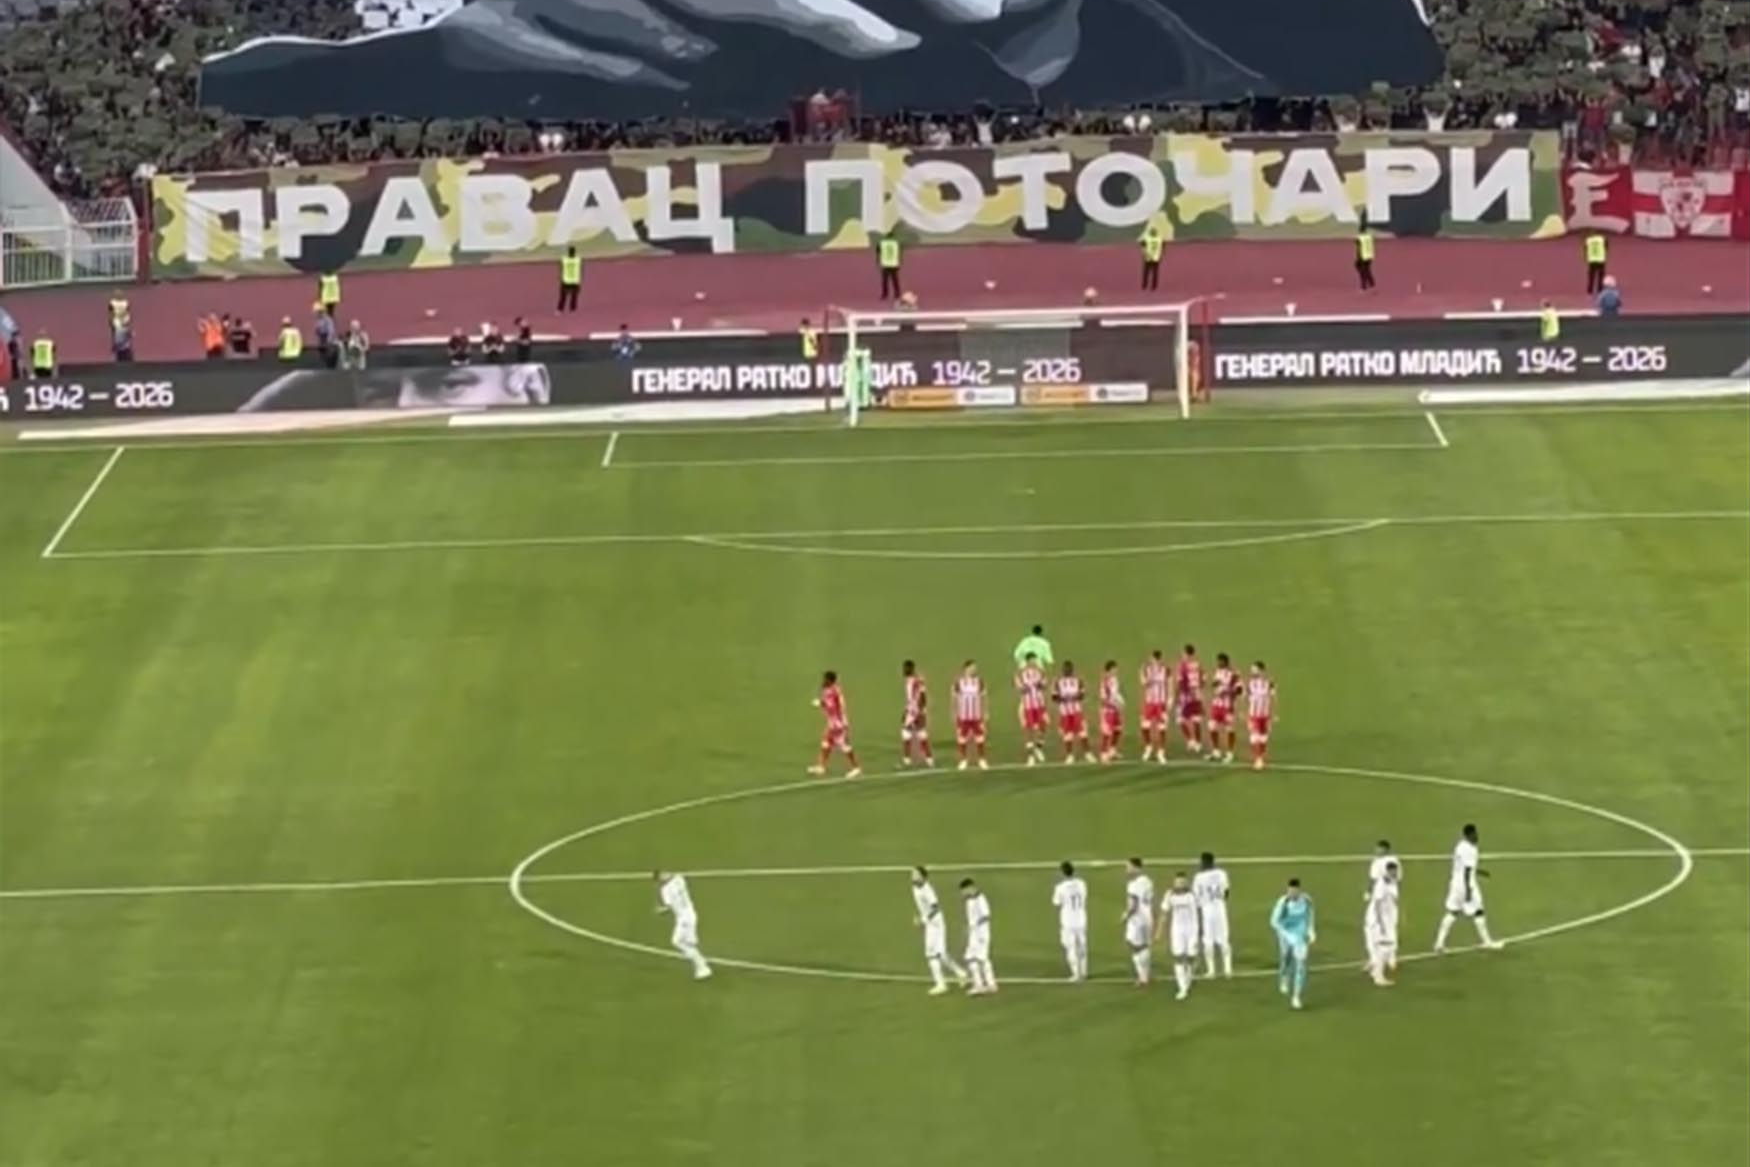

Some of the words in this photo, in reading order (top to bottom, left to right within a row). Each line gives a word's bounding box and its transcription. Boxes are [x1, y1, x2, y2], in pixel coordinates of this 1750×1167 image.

[184, 162, 735, 263] ПРАВАЦ
[804, 147, 1533, 235] ПОТОЧАРИ
[631, 365, 732, 394] ГЕНЕРАЛ
[736, 363, 811, 390] РАТКО
[816, 362, 917, 390] МЛДИЋ
[931, 360, 991, 386] 1942
[1021, 357, 1082, 384] 2026
[1214, 351, 1316, 379] ГЕНЕРАЛ
[1321, 350, 1396, 377] РАТКО
[1400, 349, 1502, 376] МЛАДИЋ
[1516, 348, 1576, 374] 1942
[1606, 346, 1667, 372] 2026
[25, 383, 85, 411] 1942
[114, 381, 174, 409] 2026
